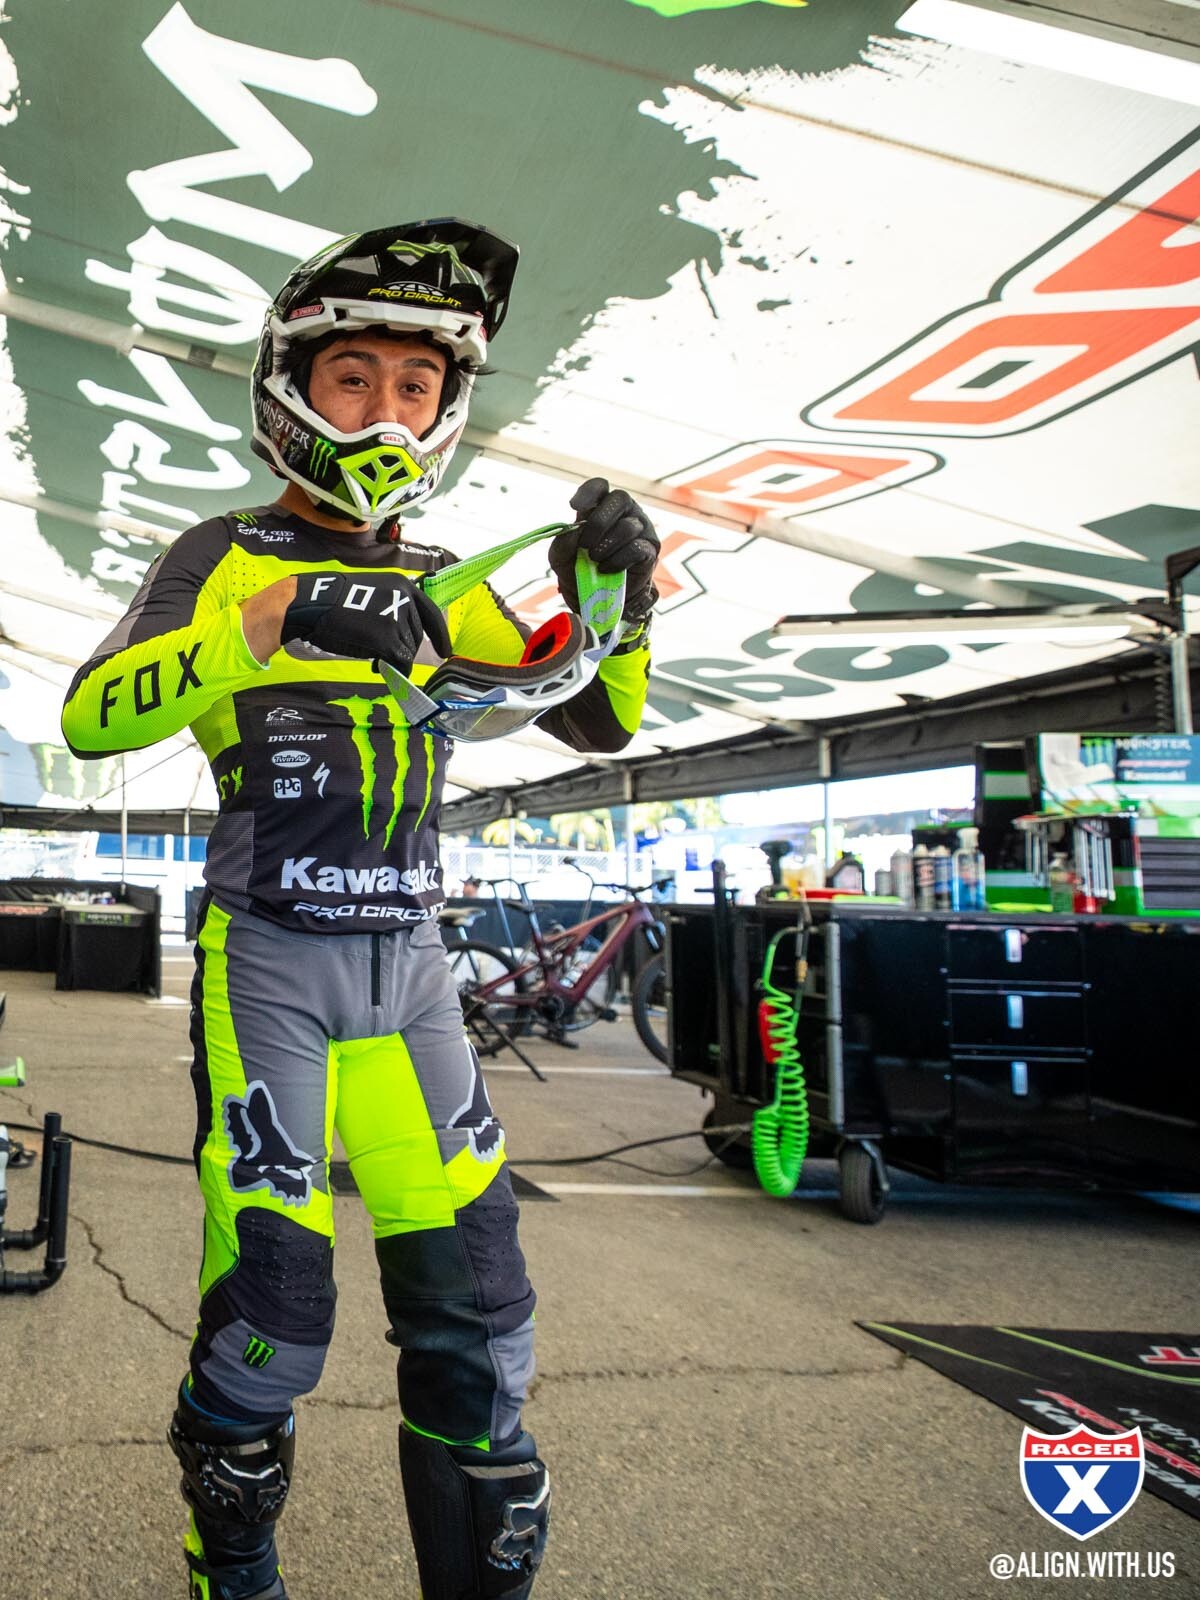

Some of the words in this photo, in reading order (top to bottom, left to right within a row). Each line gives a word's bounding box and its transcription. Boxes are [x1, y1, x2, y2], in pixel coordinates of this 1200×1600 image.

[368, 287, 403, 298] PRO
[404, 291, 462, 308] CIRCUIT
[310, 576, 410, 622] FOX
[100, 641, 203, 729] FOX
[267, 733, 328, 743] DUNLOP
[275, 777, 301, 796] PPG
[280, 856, 440, 896] Kawasaki
[293, 901, 357, 920] PRO
[360, 902, 446, 922] CIRCUIT
